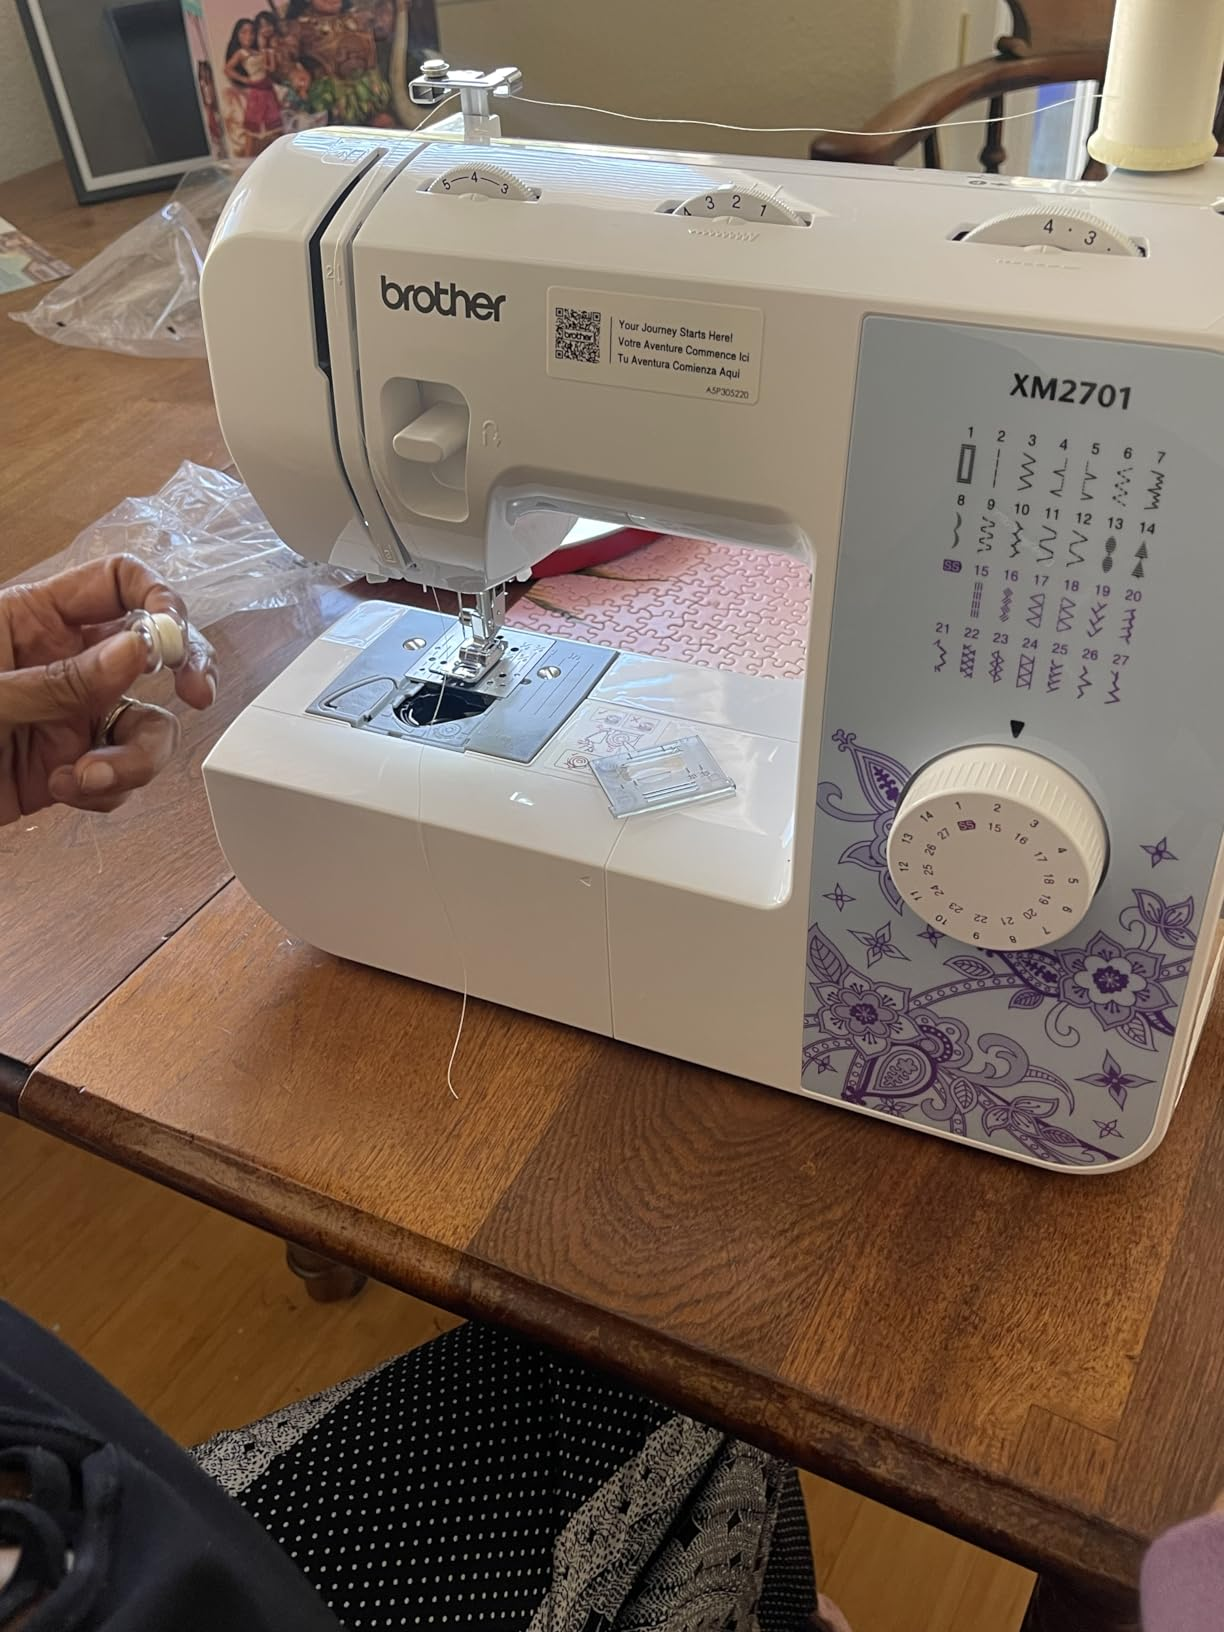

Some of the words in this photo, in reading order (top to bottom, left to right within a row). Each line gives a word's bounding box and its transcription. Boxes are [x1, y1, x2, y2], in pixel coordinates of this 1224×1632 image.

[442, 179, 451, 190] 5
[470, 171, 478, 183] 4
[500, 183, 509, 194] 3
[705, 195, 715, 210] 3
[732, 194, 741, 209] 2
[760, 204, 767, 217] 1
[1043, 218, 1054, 234] 4
[1084, 230, 1097, 246] 3
[380, 275, 506, 322] brother
[618, 319, 639, 332] Your
[641, 323, 677, 338] Journey
[679, 326, 706, 340] Starts
[708, 330, 734, 343] Here!
[618, 336, 641, 349] Votre
[643, 340, 683, 354] Aventure
[685, 345, 737, 361] Commence
[739, 351, 750, 362] Ici
[617, 353, 629, 364] Tu
[631, 355, 670, 369] Aventura
[672, 360, 717, 376] Comienza
[719, 366, 741, 380] Aqui
[1010, 372, 1132, 410] XM2701
[968, 427, 974, 438] 1
[997, 430, 1006, 442] 2
[1028, 435, 1037, 446] 3
[1059, 439, 1068, 450] 4
[1091, 443, 1100, 455] 5
[1123, 448, 1132, 459] 6
[1157, 451, 1166, 463] 7
[957, 495, 966, 506] 8
[987, 498, 995, 510] 9
[1015, 503, 1029, 516] 10
[1045, 508, 1059, 520] 11
[1076, 512, 1092, 525] 12
[1108, 517, 1123, 530] 13
[1139, 521, 1155, 535] 14
[974, 565, 989, 577] 15
[1004, 570, 1018, 582] 16
[1034, 574, 1049, 586] 17
[1064, 579, 1079, 592] 18
[1095, 584, 1110, 597] 19
[1125, 590, 1142, 602] 20
[936, 622, 949, 634] 21
[964, 627, 980, 639] 22
[993, 633, 1008, 644] 23
[1022, 638, 1038, 650] 24
[1052, 643, 1068, 655] 25
[1082, 648, 1098, 660] 26
[1112, 654, 1129, 666] 27
[994, 803, 1001, 812] 2
[920, 811, 933, 822] 14
[989, 823, 1001, 832] 15
[1030, 819, 1039, 828] 3
[902, 833, 913, 844] 13
[937, 827, 950, 840] 27
[1014, 833, 1028, 845] 16
[924, 844, 936, 856] 26
[1034, 851, 1047, 862] 17
[898, 861, 908, 871] 12
[923, 864, 934, 876] 25
[1044, 874, 1055, 885] 18
[930, 884, 944, 897] 24
[1039, 894, 1051, 906] 19
[949, 902, 963, 913] 23
[935, 914, 948, 926] 10
[973, 914, 988, 924] 22
[1023, 908, 1037, 920] 20
[1000, 916, 1014, 926] 21
[1009, 935, 1016, 943] 8
